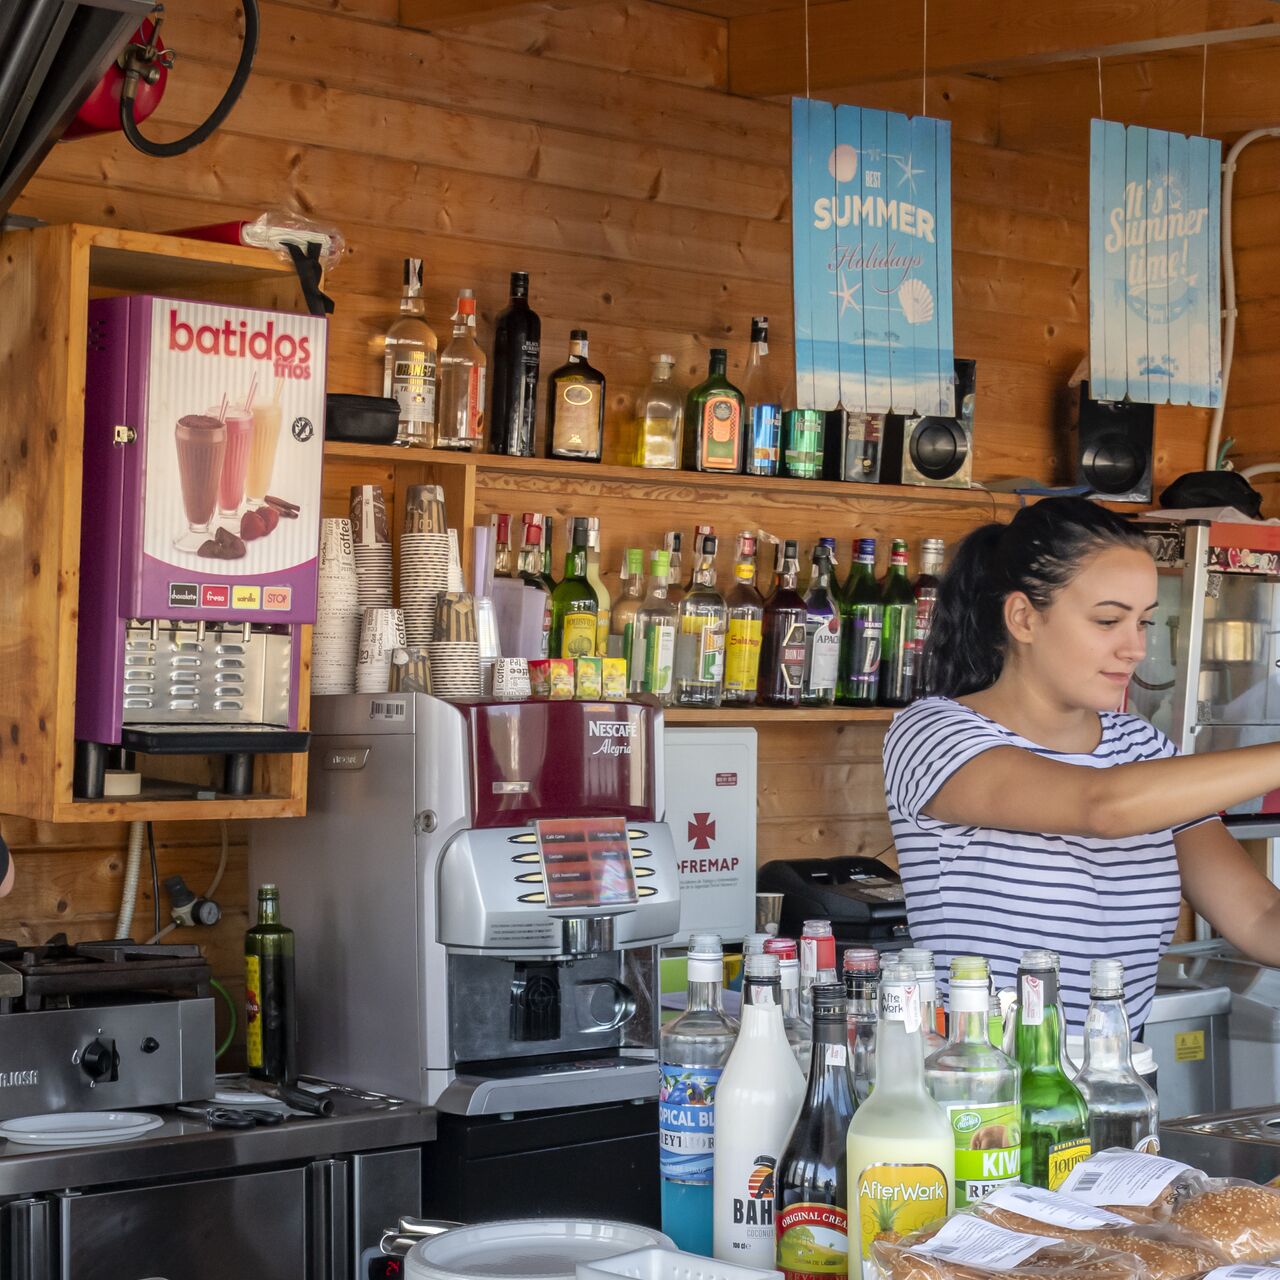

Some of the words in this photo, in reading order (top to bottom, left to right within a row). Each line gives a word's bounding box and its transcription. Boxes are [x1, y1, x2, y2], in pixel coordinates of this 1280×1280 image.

[865, 170, 882, 188] BEST
[1123, 179, 1164, 220] It's
[813, 196, 935, 244] SUMMER
[1104, 207, 1209, 254] Summer
[827, 240, 923, 293] Holidays
[1128, 241, 1190, 288] time!
[169, 309, 311, 364] batidos
[339, 519, 350, 555] coffee
[267, 593, 288, 604] STOP
[394, 609, 406, 646] coffee
[589, 721, 637, 737] NESCAFÉ
[592, 738, 632, 757] Alegria
[681, 858, 739, 874] FREMAP
[881, 992, 902, 1003] Afte
[660, 1106, 695, 1127] OPICAL
[699, 1111, 714, 1128] BL
[860, 1180, 945, 1201] AfterWork
[733, 1198, 772, 1225] BAH
[782, 1211, 820, 1228] ORIGINAL
[822, 1213, 848, 1230] CREA
